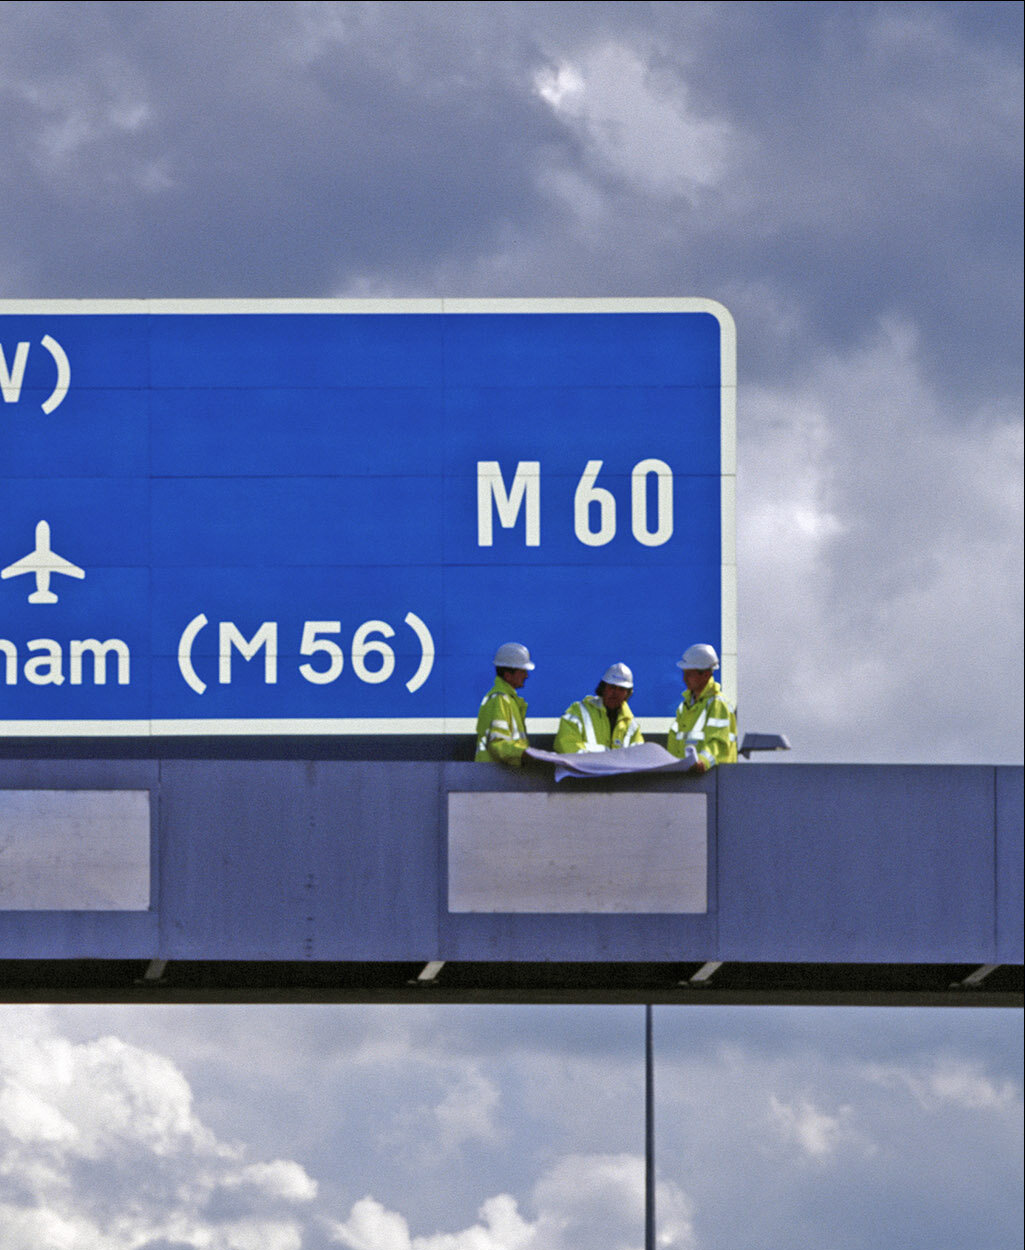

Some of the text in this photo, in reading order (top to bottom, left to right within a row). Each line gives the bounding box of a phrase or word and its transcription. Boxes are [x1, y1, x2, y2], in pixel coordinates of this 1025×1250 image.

[477, 459, 674, 547] M 60
[177, 613, 278, 695] (M
[299, 611, 435, 695] 56)
